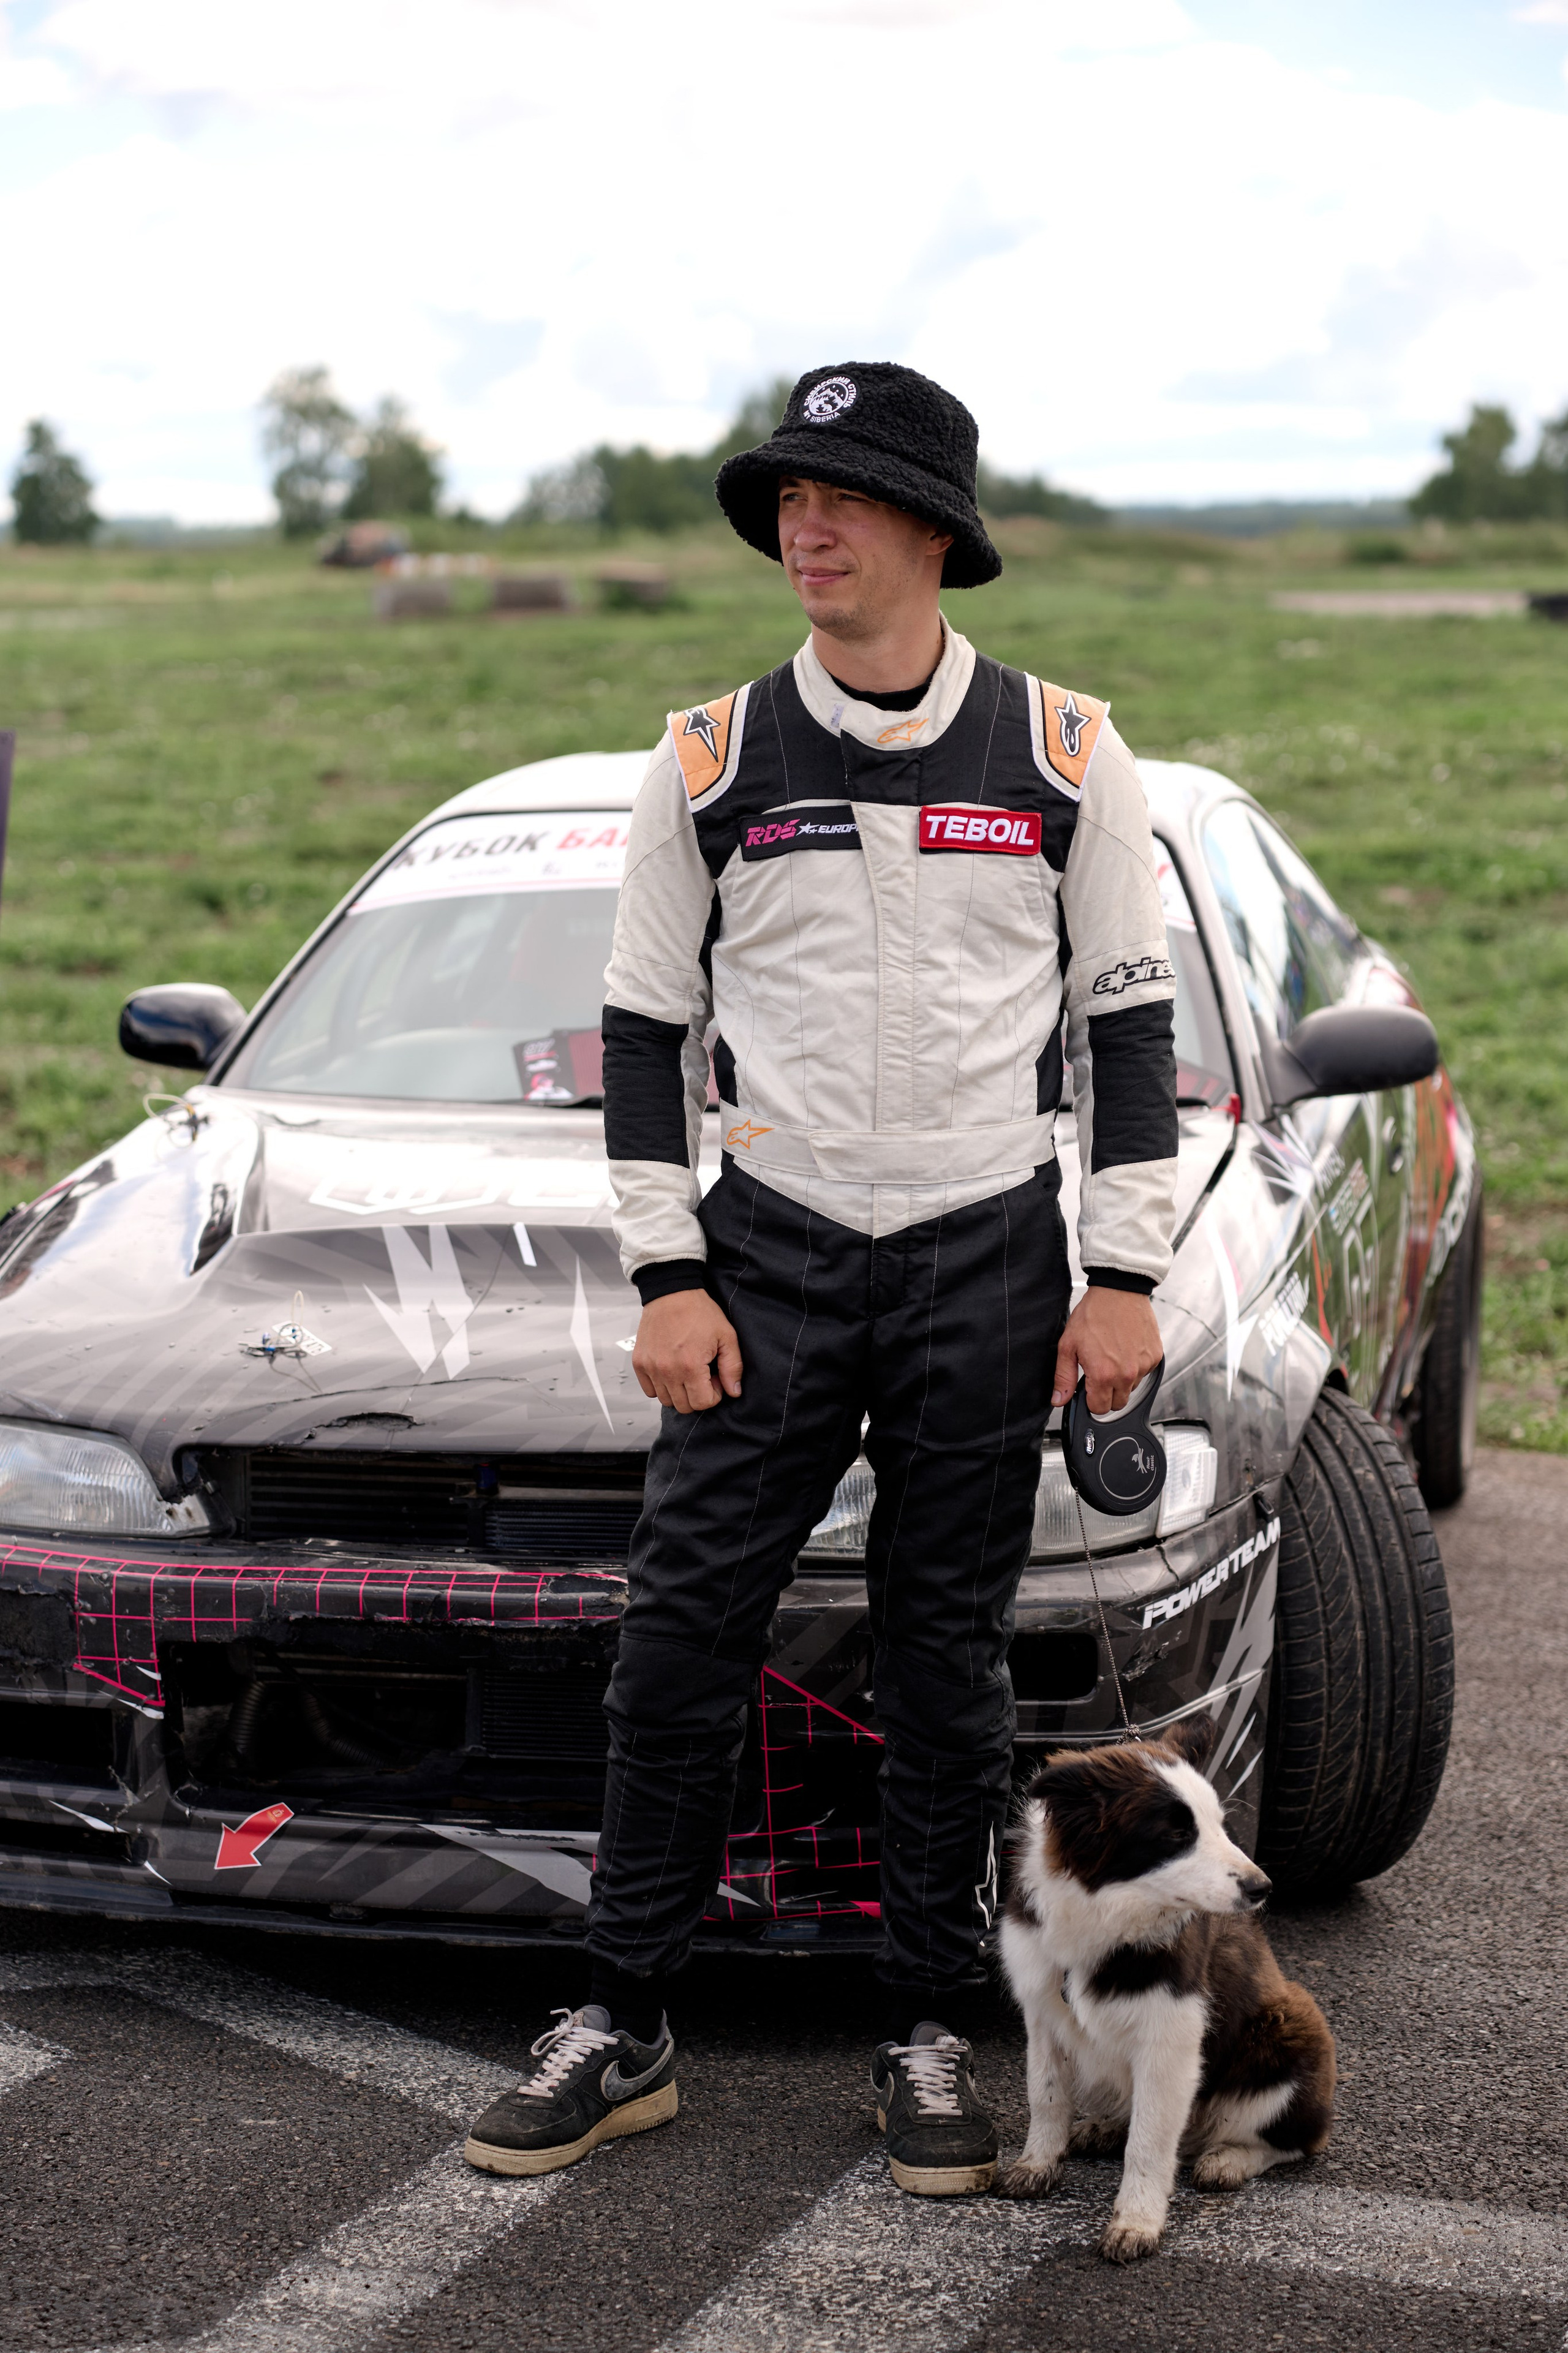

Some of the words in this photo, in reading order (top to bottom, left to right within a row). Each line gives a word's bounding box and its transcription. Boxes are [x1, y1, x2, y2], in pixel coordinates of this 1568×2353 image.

[804, 376, 851, 406] СИБИРСКИЙ
[843, 383, 857, 408] СТИЛЬ
[803, 410, 812, 420] MY
[810, 412, 841, 423] SIBERIA
[745, 818, 801, 847] RDS
[818, 823, 859, 834] EUROP
[926, 815, 1035, 845] TEBOIL
[393, 830, 551, 871] КУБОК
